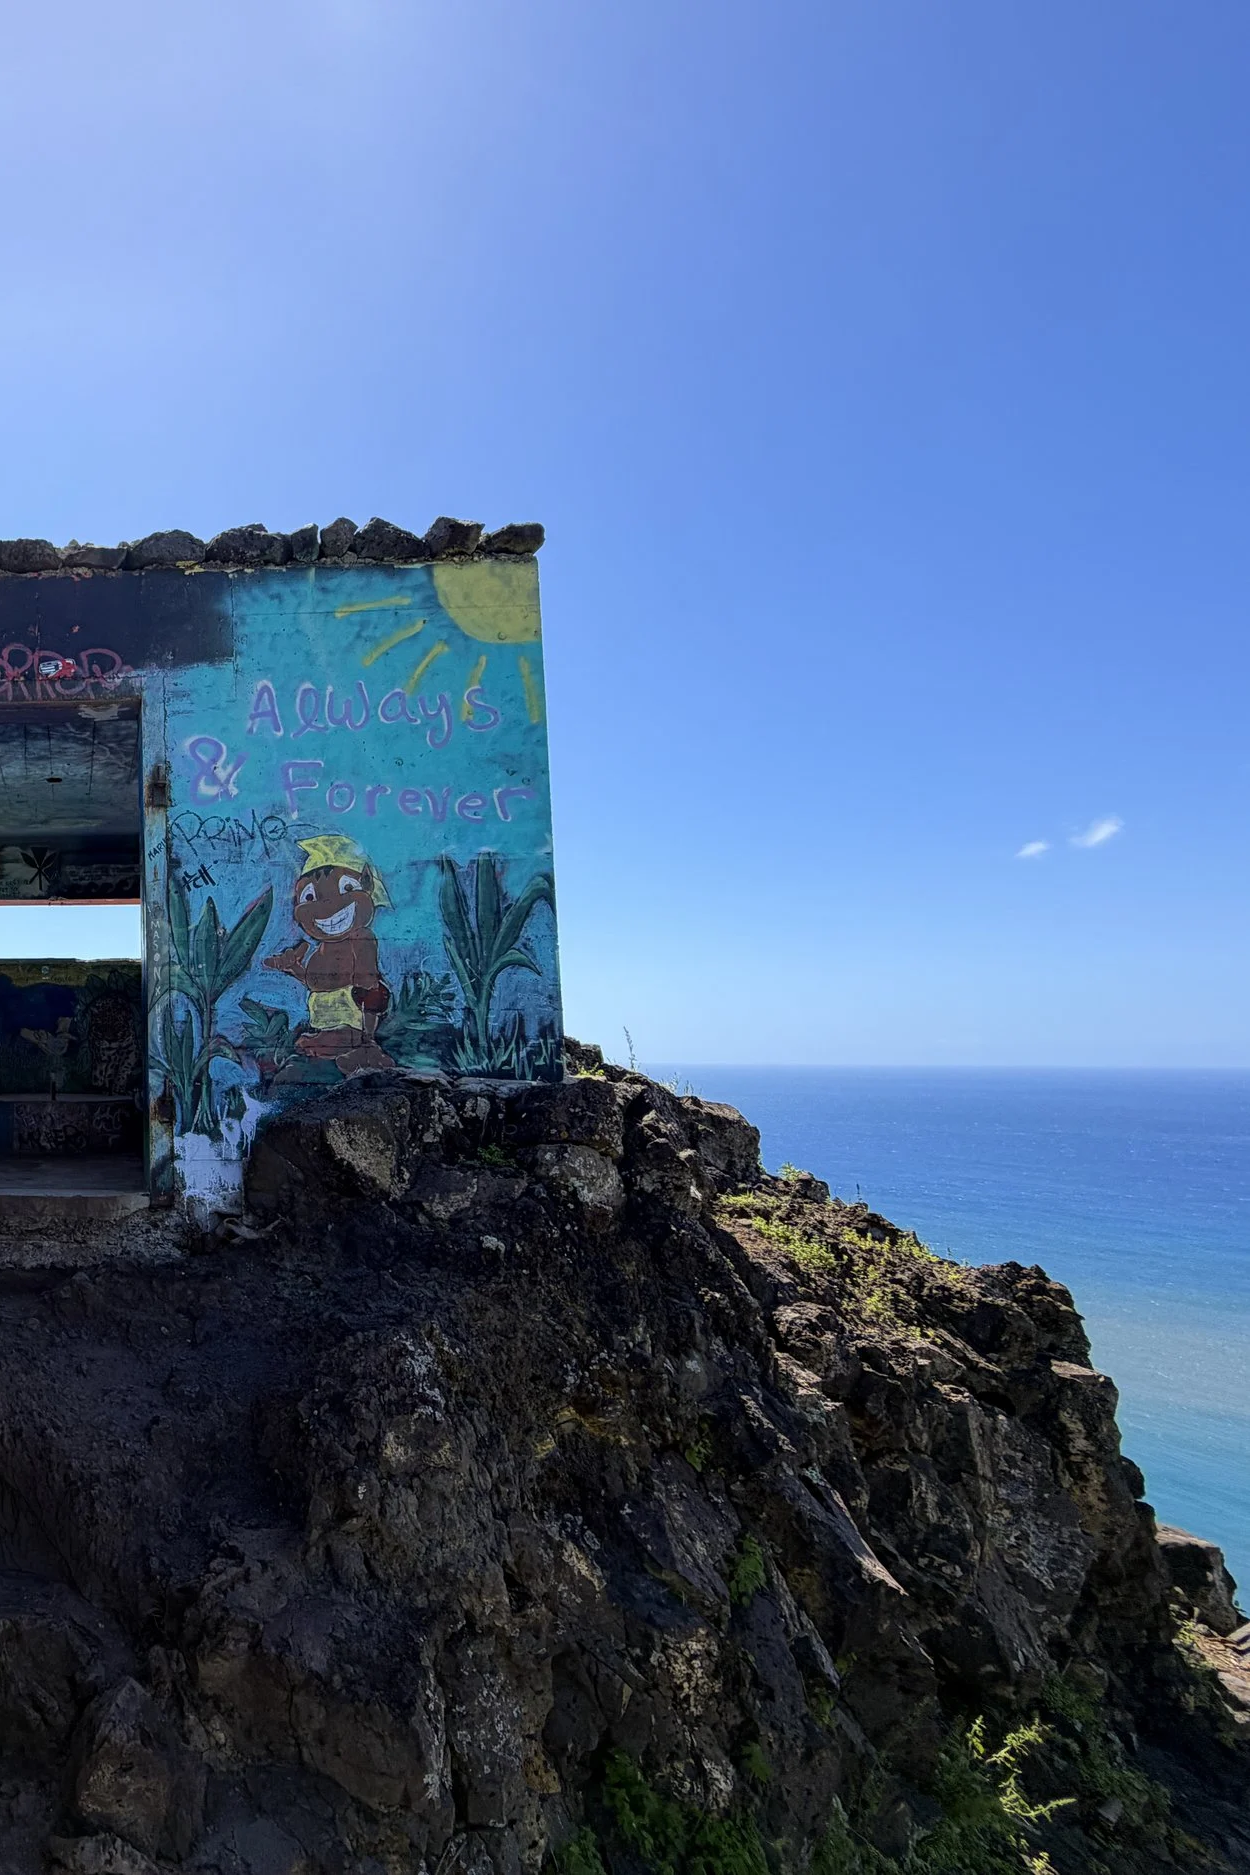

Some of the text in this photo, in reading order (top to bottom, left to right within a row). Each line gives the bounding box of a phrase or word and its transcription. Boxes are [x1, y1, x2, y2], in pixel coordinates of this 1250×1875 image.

[184, 736, 538, 822] & Forever
[150, 920, 162, 982] MASON
